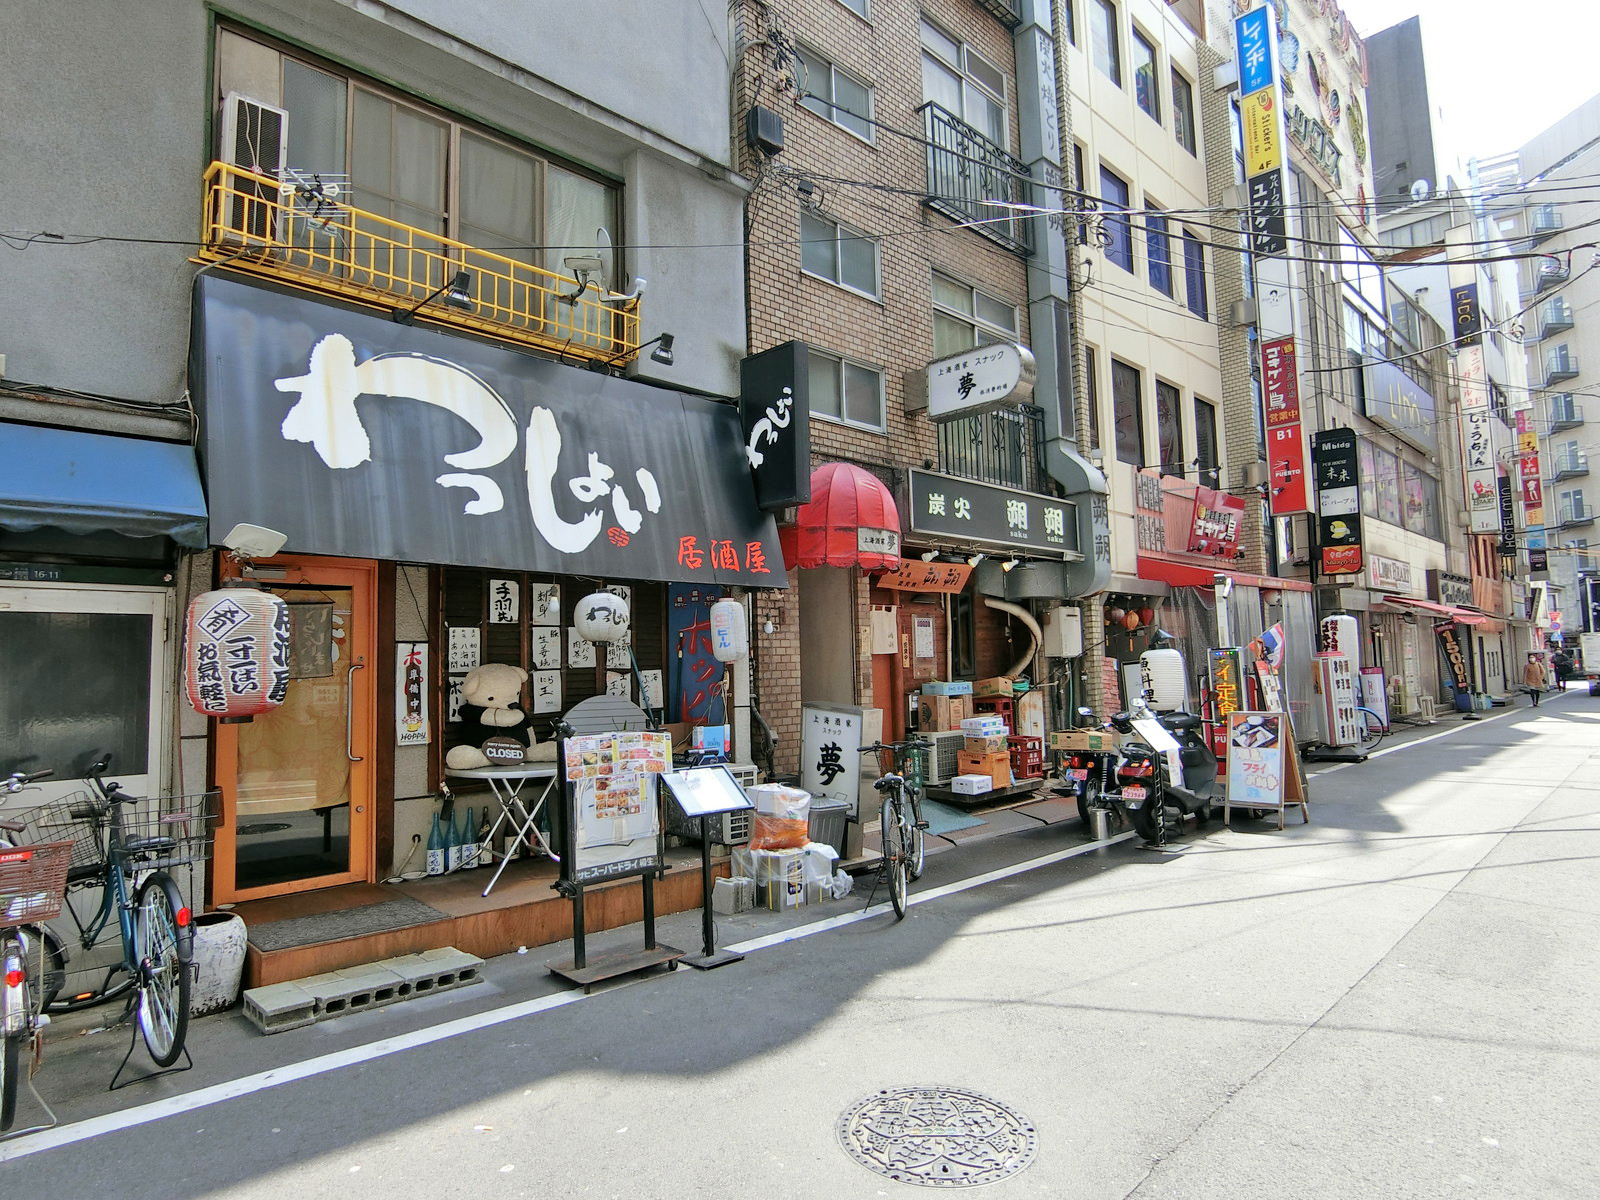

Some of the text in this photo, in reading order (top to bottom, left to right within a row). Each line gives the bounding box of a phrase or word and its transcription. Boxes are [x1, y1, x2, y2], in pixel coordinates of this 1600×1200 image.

[1243, 19, 1266, 75] レインボー
[1040, 36, 1056, 150] 炭火焼とり
[1251, 77, 1262, 87] 5F
[1261, 114, 1273, 152] Sticker's
[1258, 160, 1272, 170] 4F
[1263, 243, 1277, 253] 3F
[938, 350, 1004, 376] 上海酒家 スナック
[1470, 348, 1481, 375] マニラ
[957, 371, 976, 401] 夢
[1466, 398, 1483, 407] 2F
[745, 386, 793, 469] わっしょい
[1270, 409, 1298, 423] 営業中
[274, 332, 662, 556] わっしょい
[1276, 429, 1292, 441] B1
[1470, 413, 1485, 467] しょうちゃん
[1275, 468, 1301, 478] PUERTO
[1327, 467, 1351, 482] 未来
[927, 492, 971, 521] 炭火
[863, 533, 896, 550] 上海酒家 夢
[1009, 531, 1064, 545] saku saku
[1503, 513, 1515, 547] HOTEL
[34, 570, 59, 579] 16-11
[677, 535, 770, 589] 居酒屋
[495, 582, 513, 623] 手羽先
[717, 629, 731, 649] ビール
[460, 643, 469, 668] 八海山
[676, 607, 721, 723] ホッピ
[408, 668, 421, 711] 準備中
[1216, 658, 1238, 716] イ定食
[814, 714, 852, 728] 上海酒家
[823, 727, 843, 736] スナック
[487, 748, 524, 760] CLOSED
[817, 741, 846, 786] 夢
[1243, 763, 1266, 775] フライ
[578, 857, 655, 882] サヒ スーパードライ 樽生
